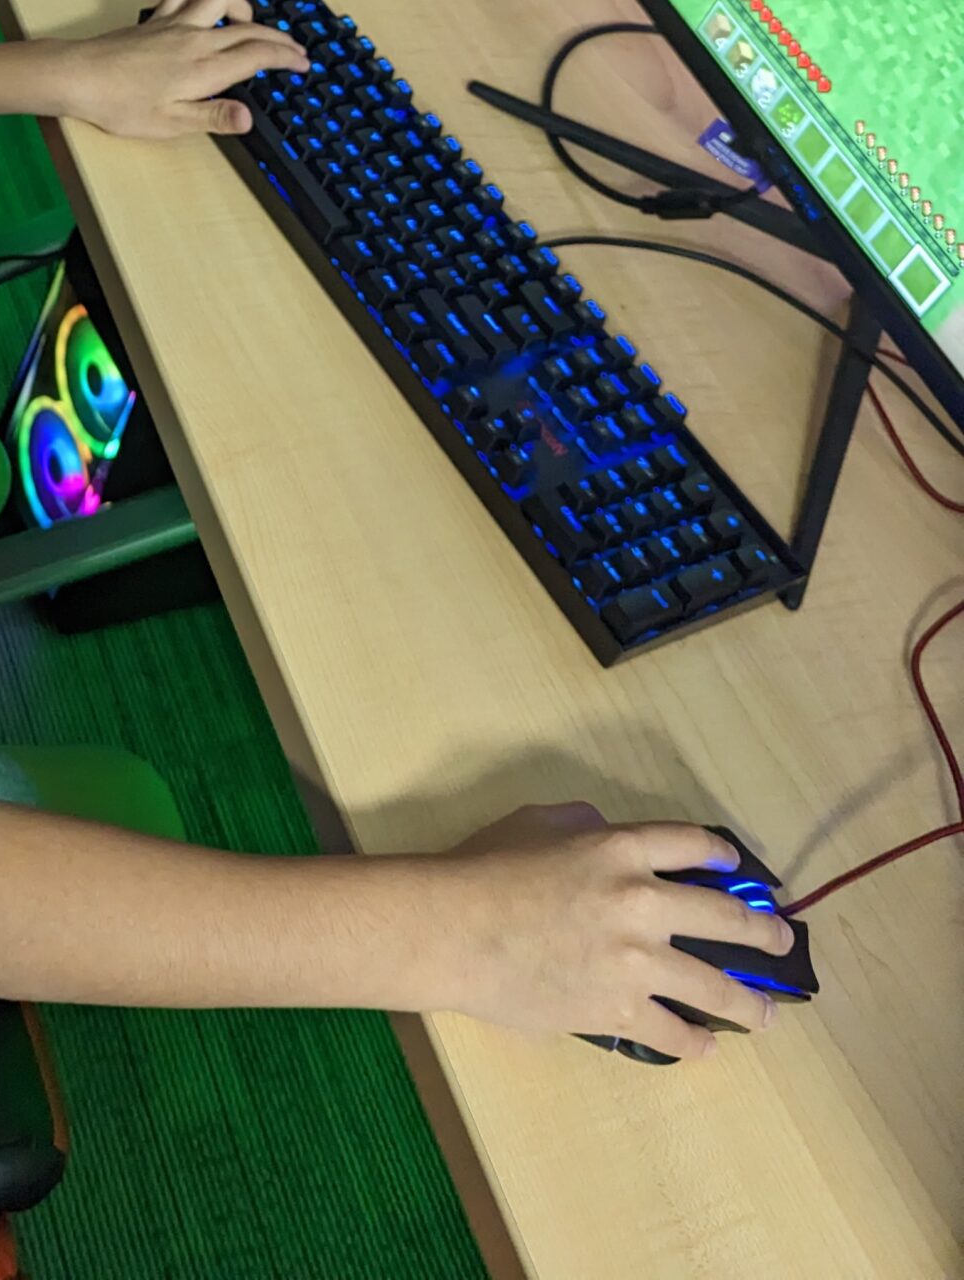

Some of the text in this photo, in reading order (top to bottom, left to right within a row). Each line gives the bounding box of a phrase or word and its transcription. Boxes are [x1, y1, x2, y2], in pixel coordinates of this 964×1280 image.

[714, 37, 728, 52] 4
[735, 62, 749, 80] 3
[756, 91, 772, 109] 2
[780, 121, 796, 138] 3
